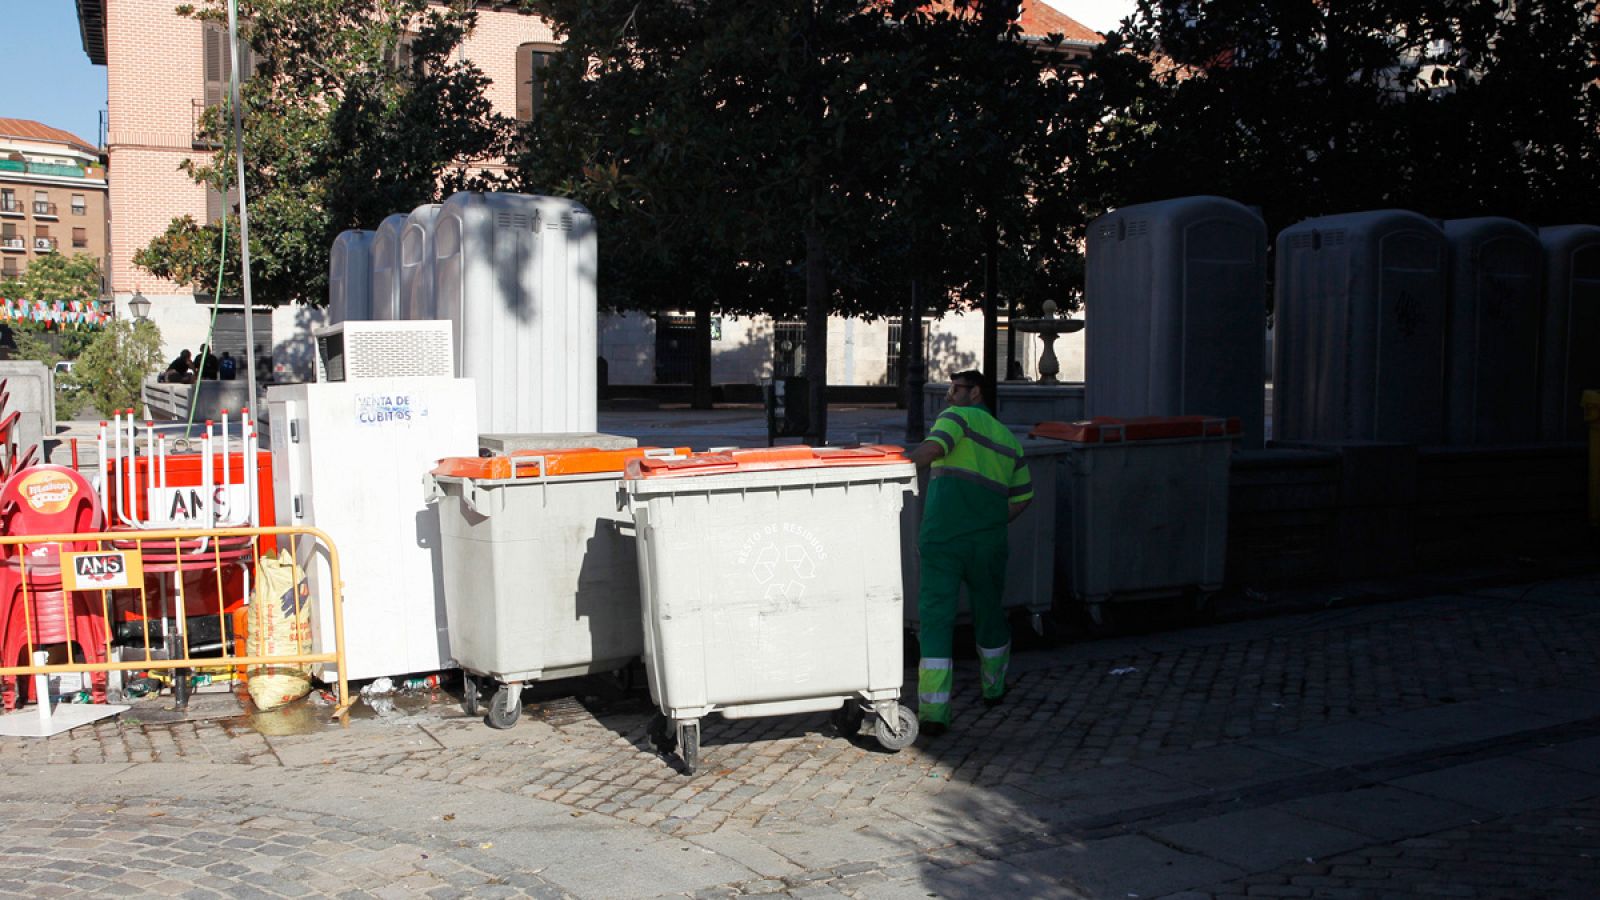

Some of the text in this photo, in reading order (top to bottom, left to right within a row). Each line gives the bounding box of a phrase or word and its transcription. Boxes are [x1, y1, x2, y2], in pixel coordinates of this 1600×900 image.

[395, 395, 410, 406] DE
[737, 522, 828, 564] RESTO DE RESIDUOS
[80, 556, 121, 575] AMS
